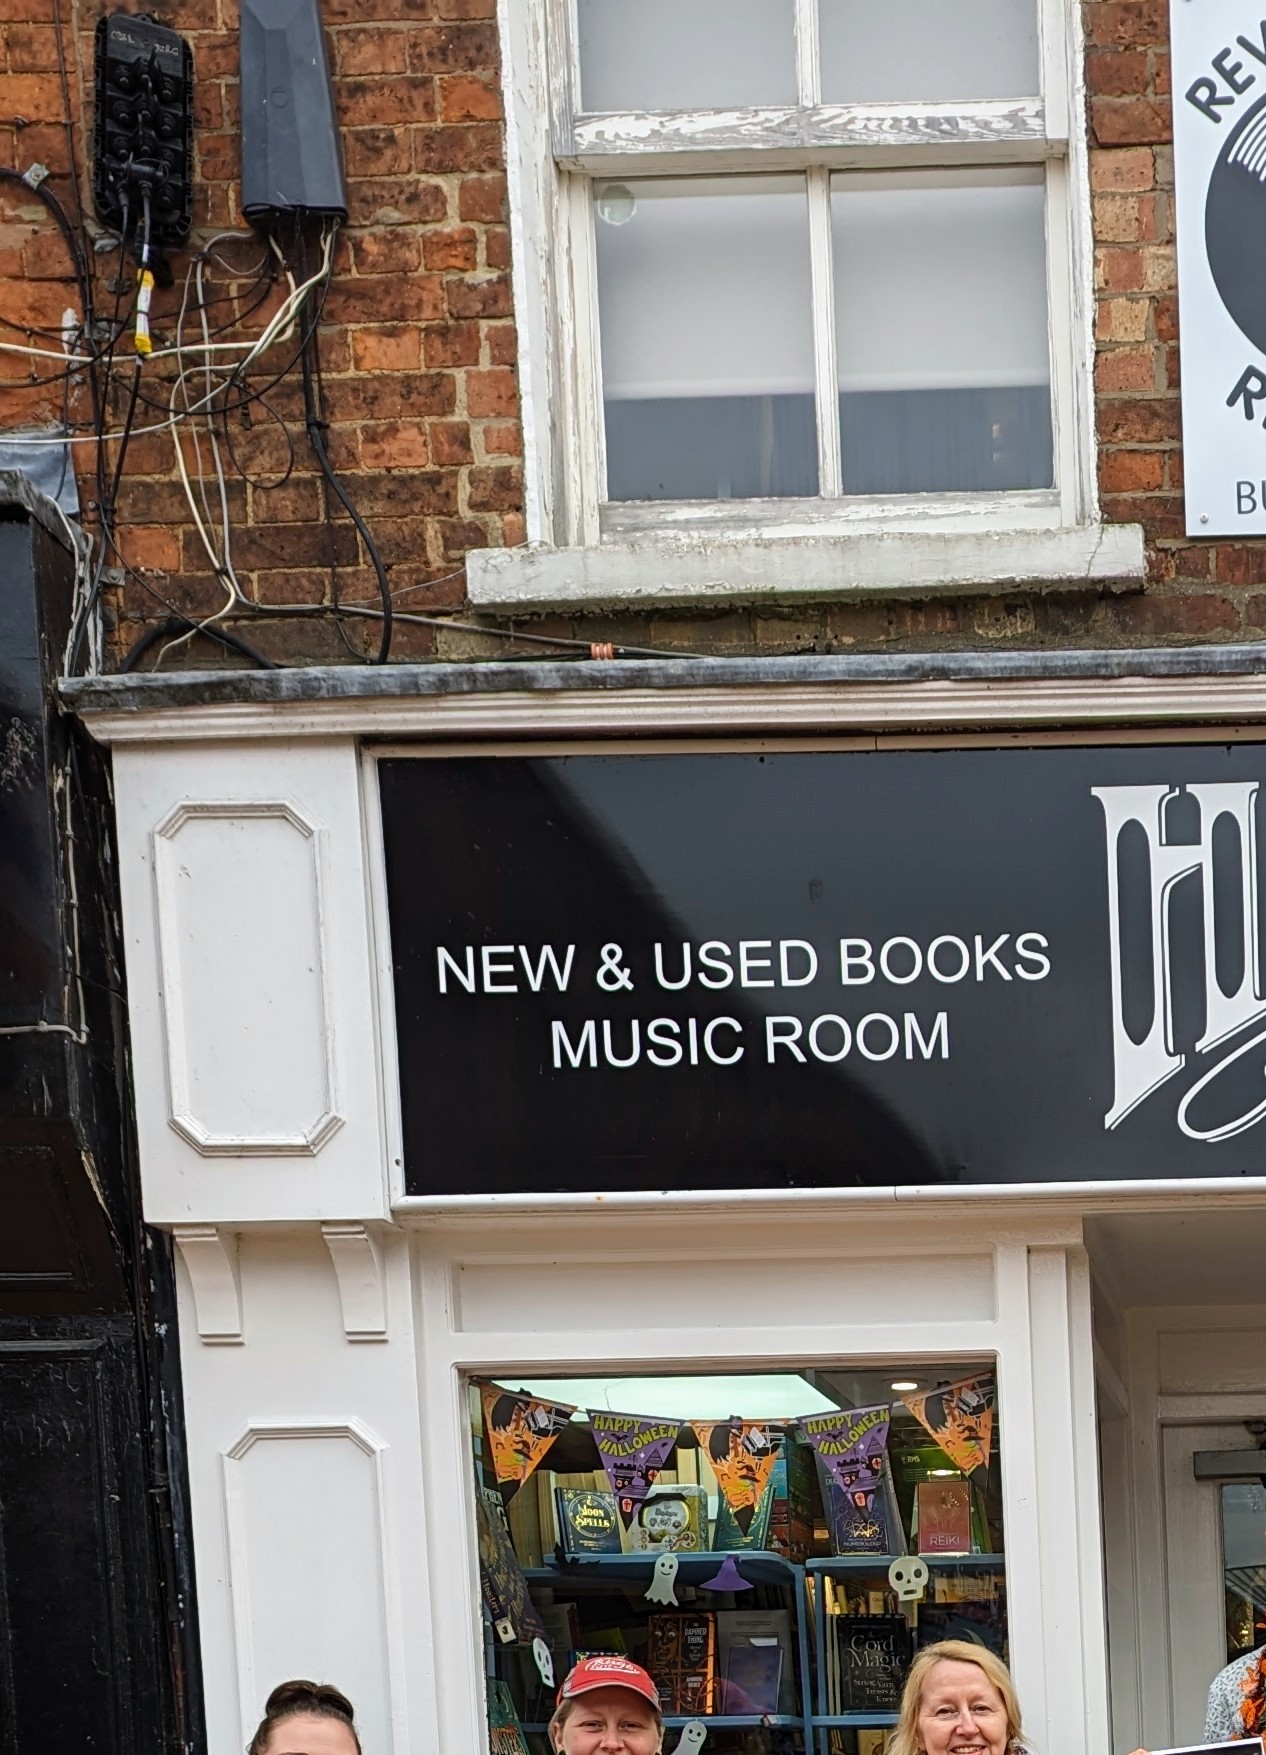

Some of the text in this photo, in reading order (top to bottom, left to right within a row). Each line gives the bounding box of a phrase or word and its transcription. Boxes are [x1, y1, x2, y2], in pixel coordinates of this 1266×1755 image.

[437, 932, 1051, 995] NEW & USED BOOKS
[551, 1012, 951, 1070] MUSIC ROOM
[593, 1415, 642, 1434] HAPPY
[807, 1414, 853, 1434] HAPPY
[817, 1408, 891, 1456] HALLOWEEN
[599, 1424, 680, 1458] HALLOWEEN
[575, 1514, 610, 1529] SPELLS
[930, 1535, 960, 1547] REIKI
[851, 1634, 895, 1652] Cord
[846, 1648, 906, 1673] Magic
